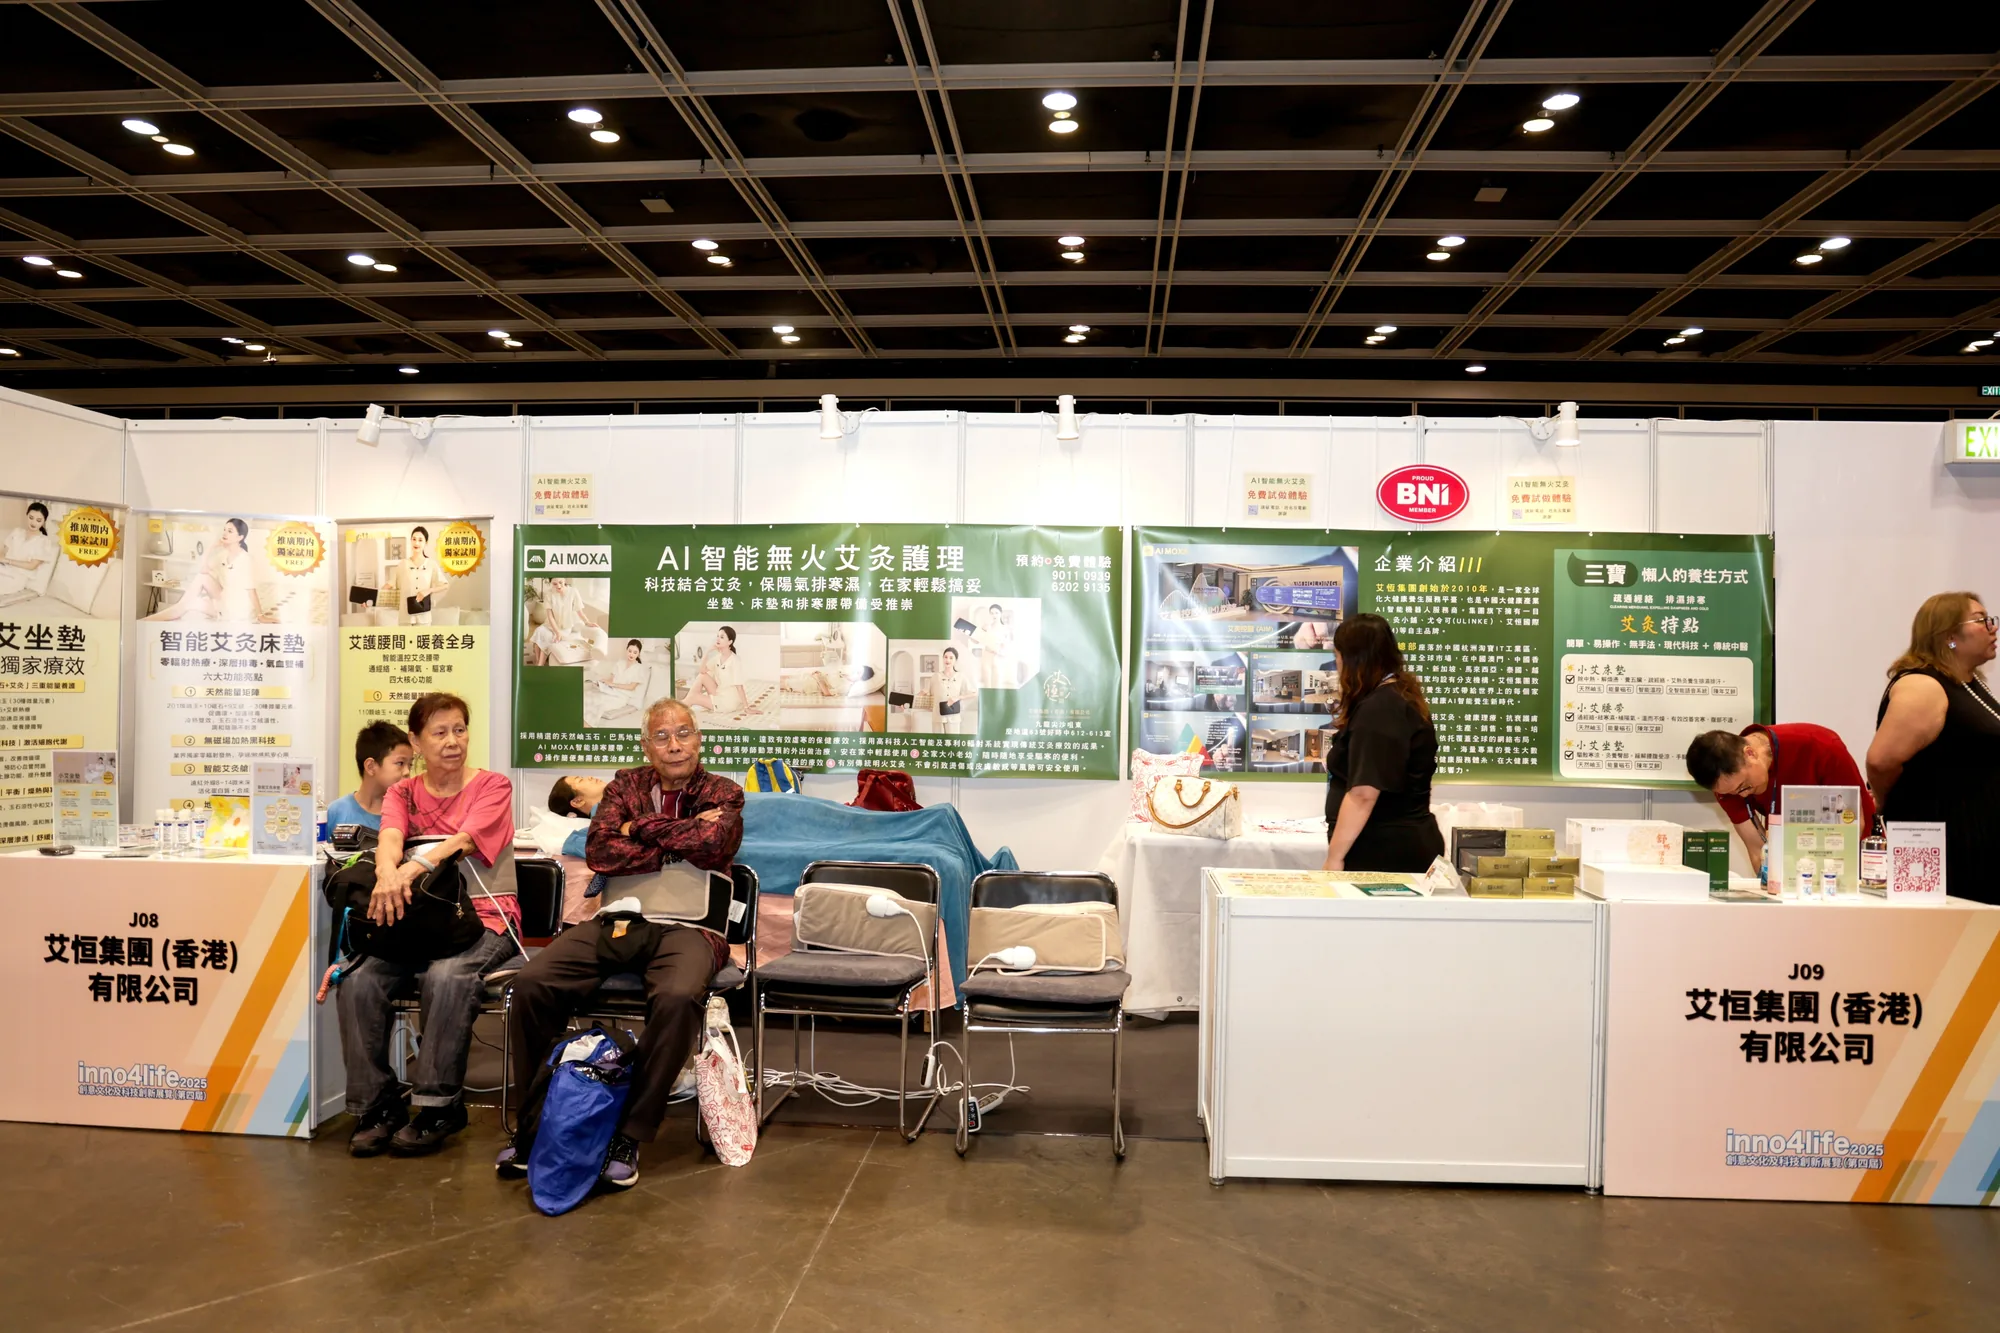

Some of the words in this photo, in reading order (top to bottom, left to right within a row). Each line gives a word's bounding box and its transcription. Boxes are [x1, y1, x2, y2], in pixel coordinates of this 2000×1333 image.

[70, 522, 109, 535] 推廣期內
[70, 535, 108, 546] 獨家試用
[277, 535, 314, 547] 推廣期內
[444, 537, 476, 546] 推廣期內
[78, 548, 99, 556] FREE
[277, 547, 314, 558] 獨家試用
[444, 548, 476, 557] 獨家試用
[549, 553, 564, 565] AI
[567, 553, 609, 565] MOXA
[1374, 555, 1456, 573] 企業介紹
[1052, 571, 1079, 580] 9011
[1584, 563, 1627, 585] 三寶
[1641, 566, 1748, 585] 懶人的養生方式
[1051, 582, 1079, 592] 6202
[1620, 614, 1700, 634] 艾灸特點
[0, 622, 85, 651] 艾坐墊
[160, 630, 305, 654] 智能艾灸床墊
[383, 654, 440, 662] 智能溫控艾灸腰帶
[1, 656, 85, 676] 獨家療效
[1577, 664, 1626, 675] 小艾床墊
[203, 672, 263, 682] 六大功能亮點
[389, 676, 433, 684] 四大核心功能
[205, 688, 260, 697] 天然能量矩陣
[1577, 702, 1624, 713] 小艾腰帶
[1577, 740, 1624, 751] 小艾坐墊
[204, 764, 250, 773] 智能艾灸艙
[129, 912, 159, 928] J08
[1788, 964, 1824, 980] J09
[88, 972, 198, 1006] 有限公司
[1740, 1030, 1874, 1065] 有限公司
